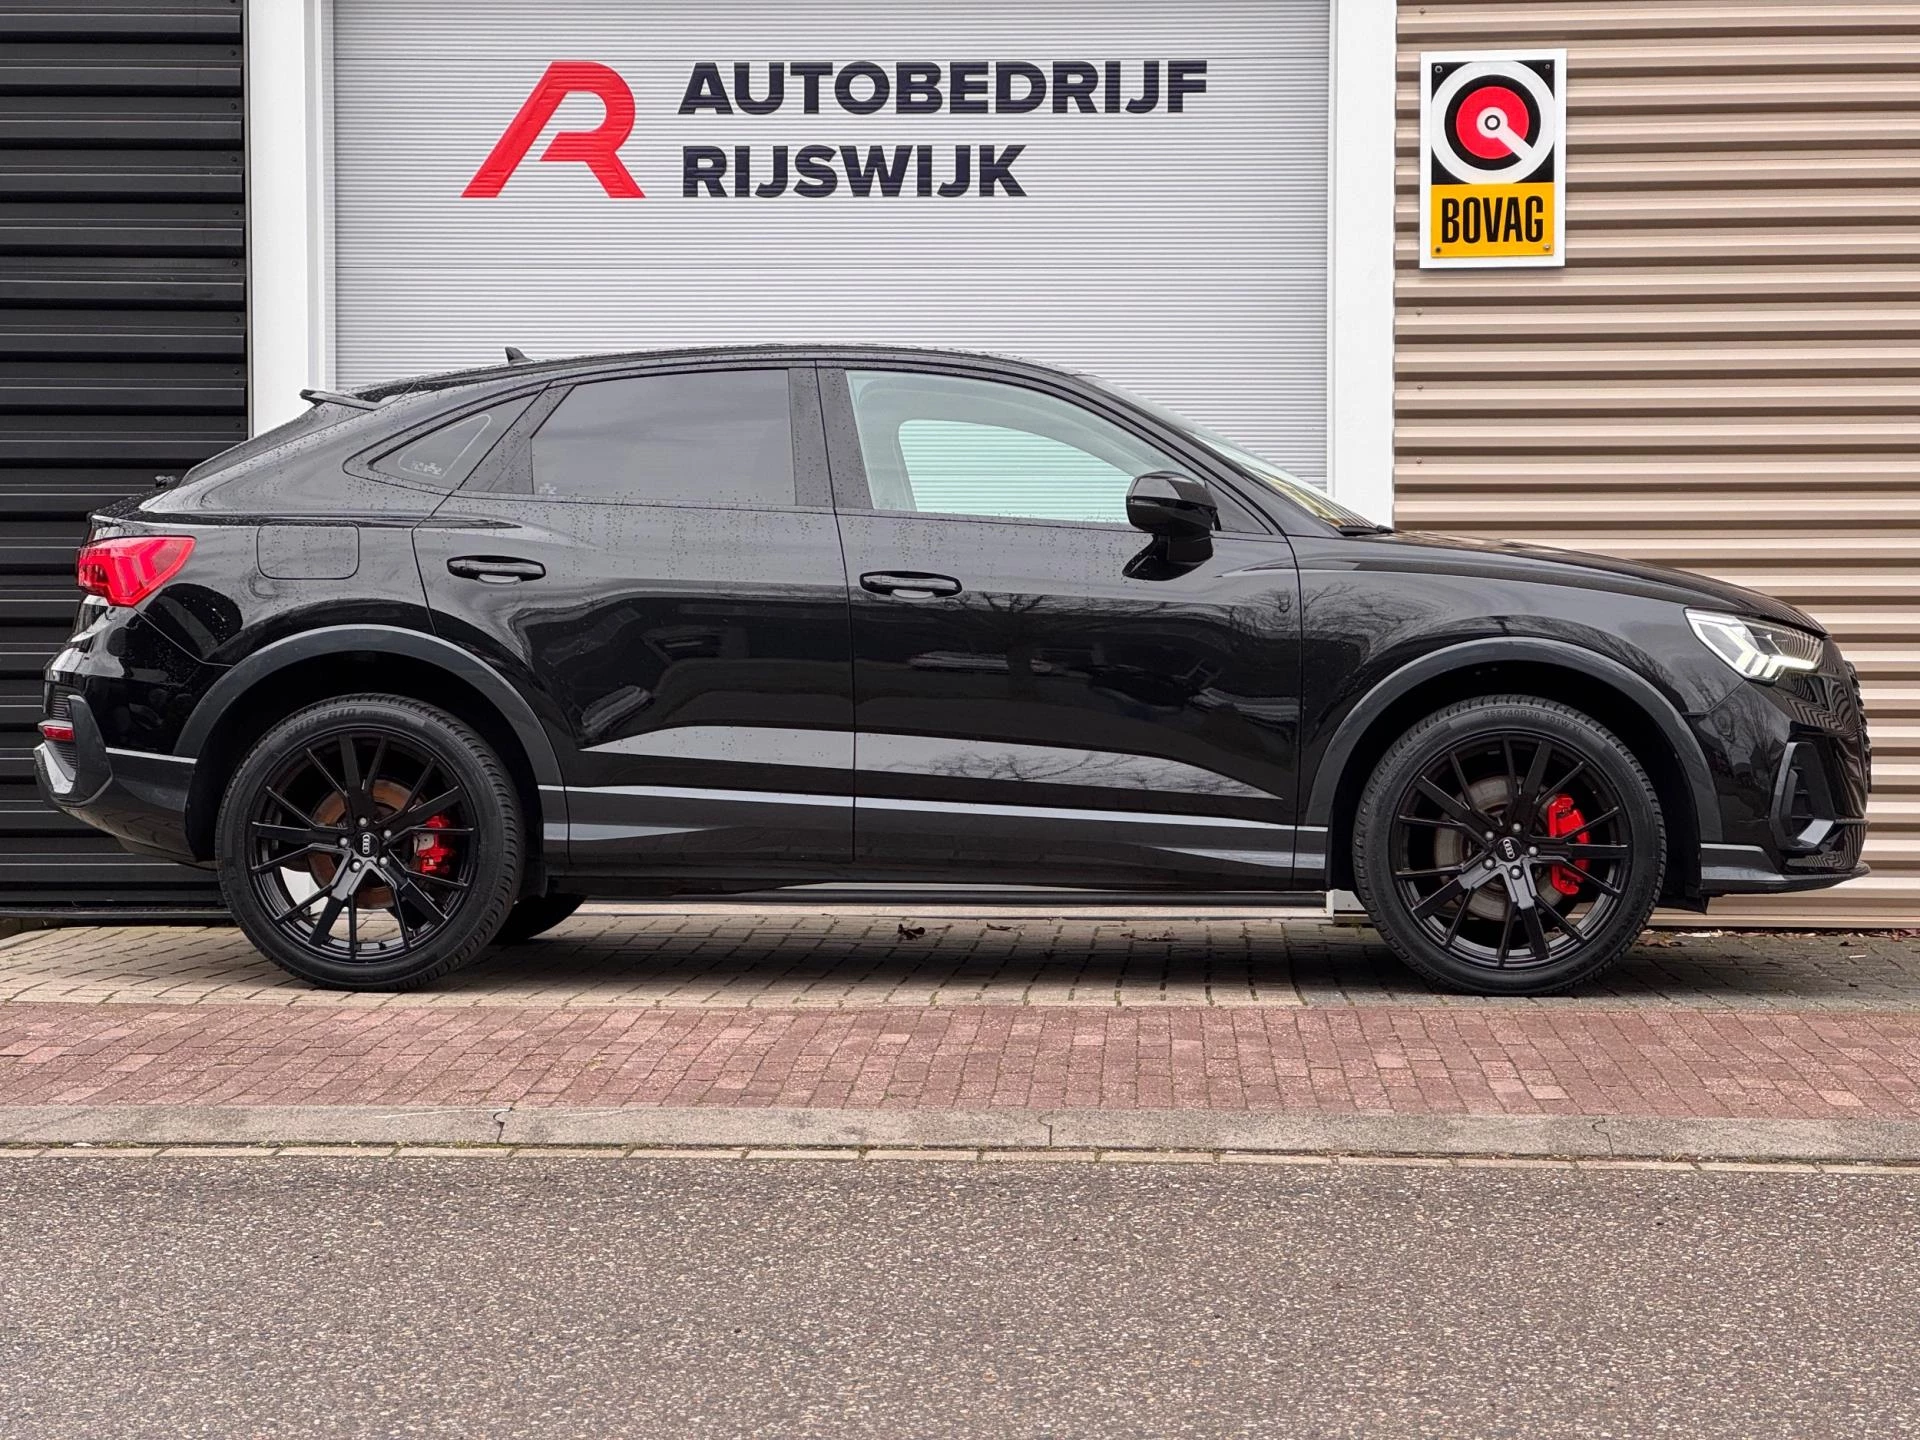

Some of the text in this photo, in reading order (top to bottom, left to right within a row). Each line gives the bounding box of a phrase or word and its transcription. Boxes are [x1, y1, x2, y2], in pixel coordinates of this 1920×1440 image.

[677, 60, 1207, 115] AUTOBEDRIJF
[682, 144, 1027, 198] RIJSWIJK
[1441, 195, 1544, 244] BOVAG
